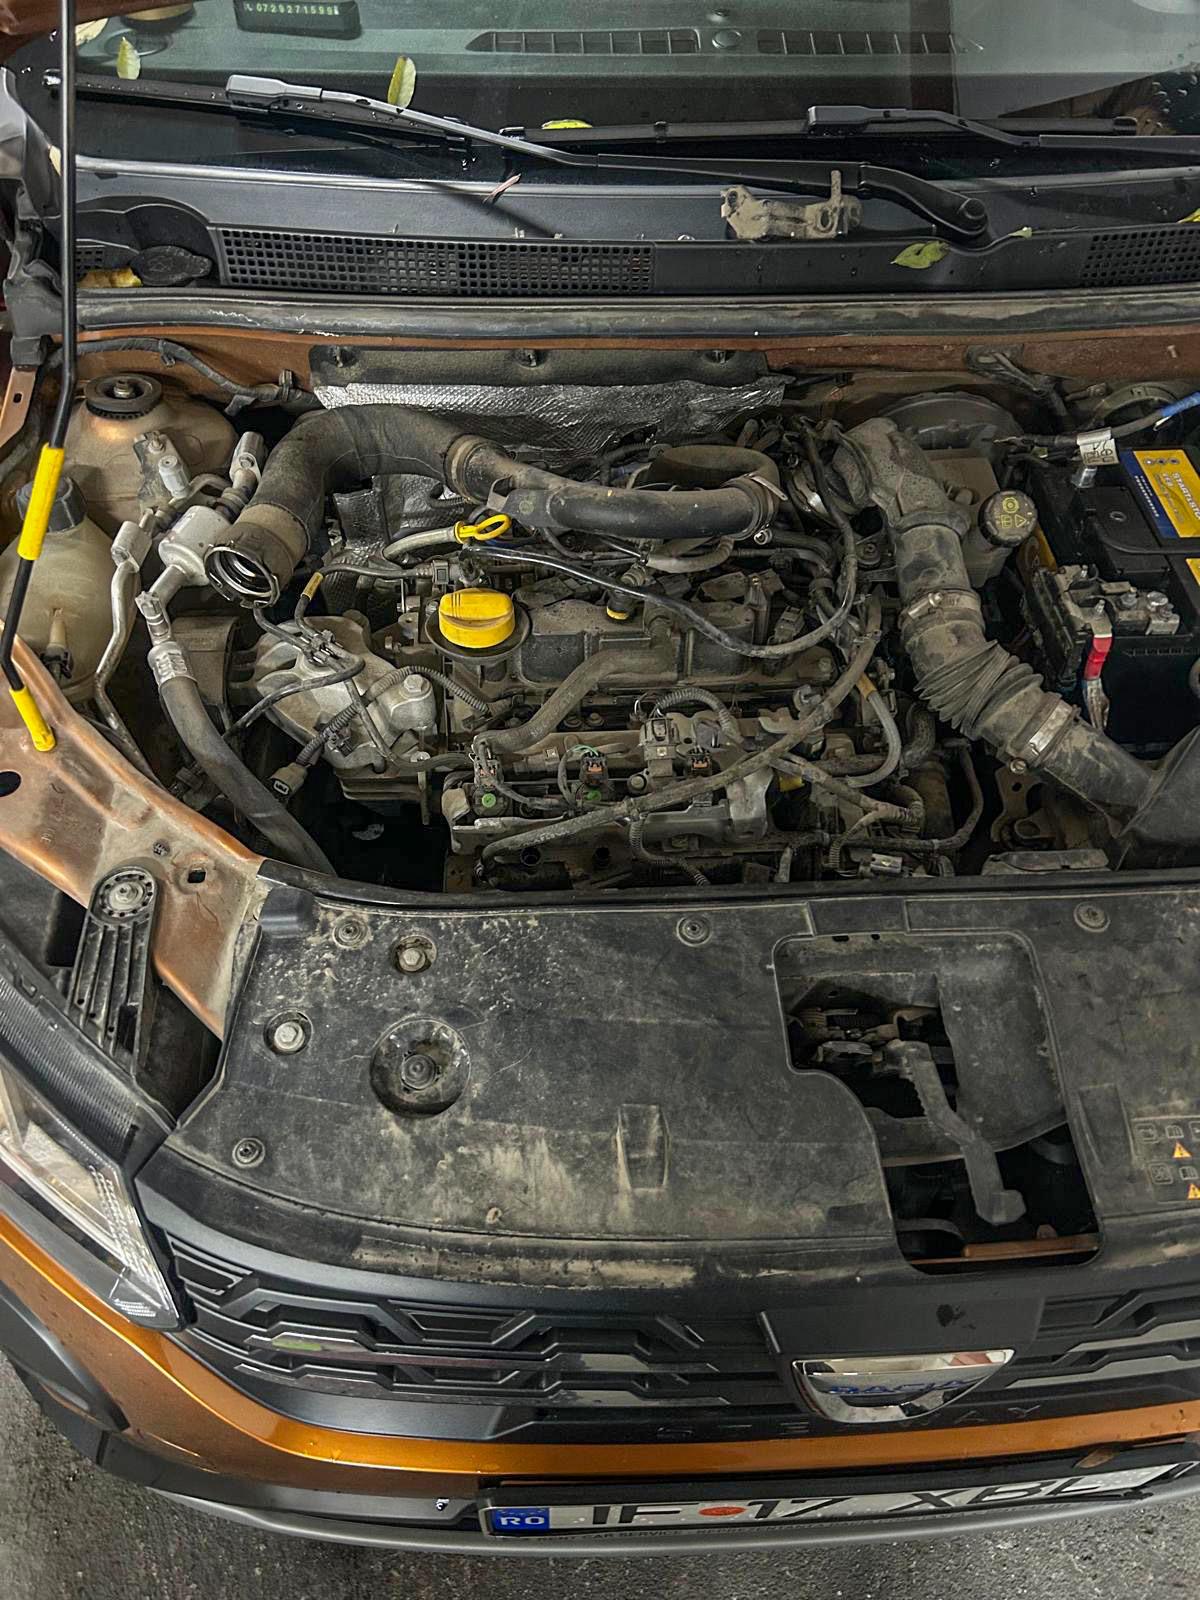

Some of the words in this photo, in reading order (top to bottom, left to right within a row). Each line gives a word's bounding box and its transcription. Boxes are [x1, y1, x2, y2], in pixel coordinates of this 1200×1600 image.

[656, 1404, 1041, 1440] STEWAY
[500, 1515, 545, 1526] RO
[592, 1502, 699, 1526] IF
[748, 1496, 853, 1520] 17
